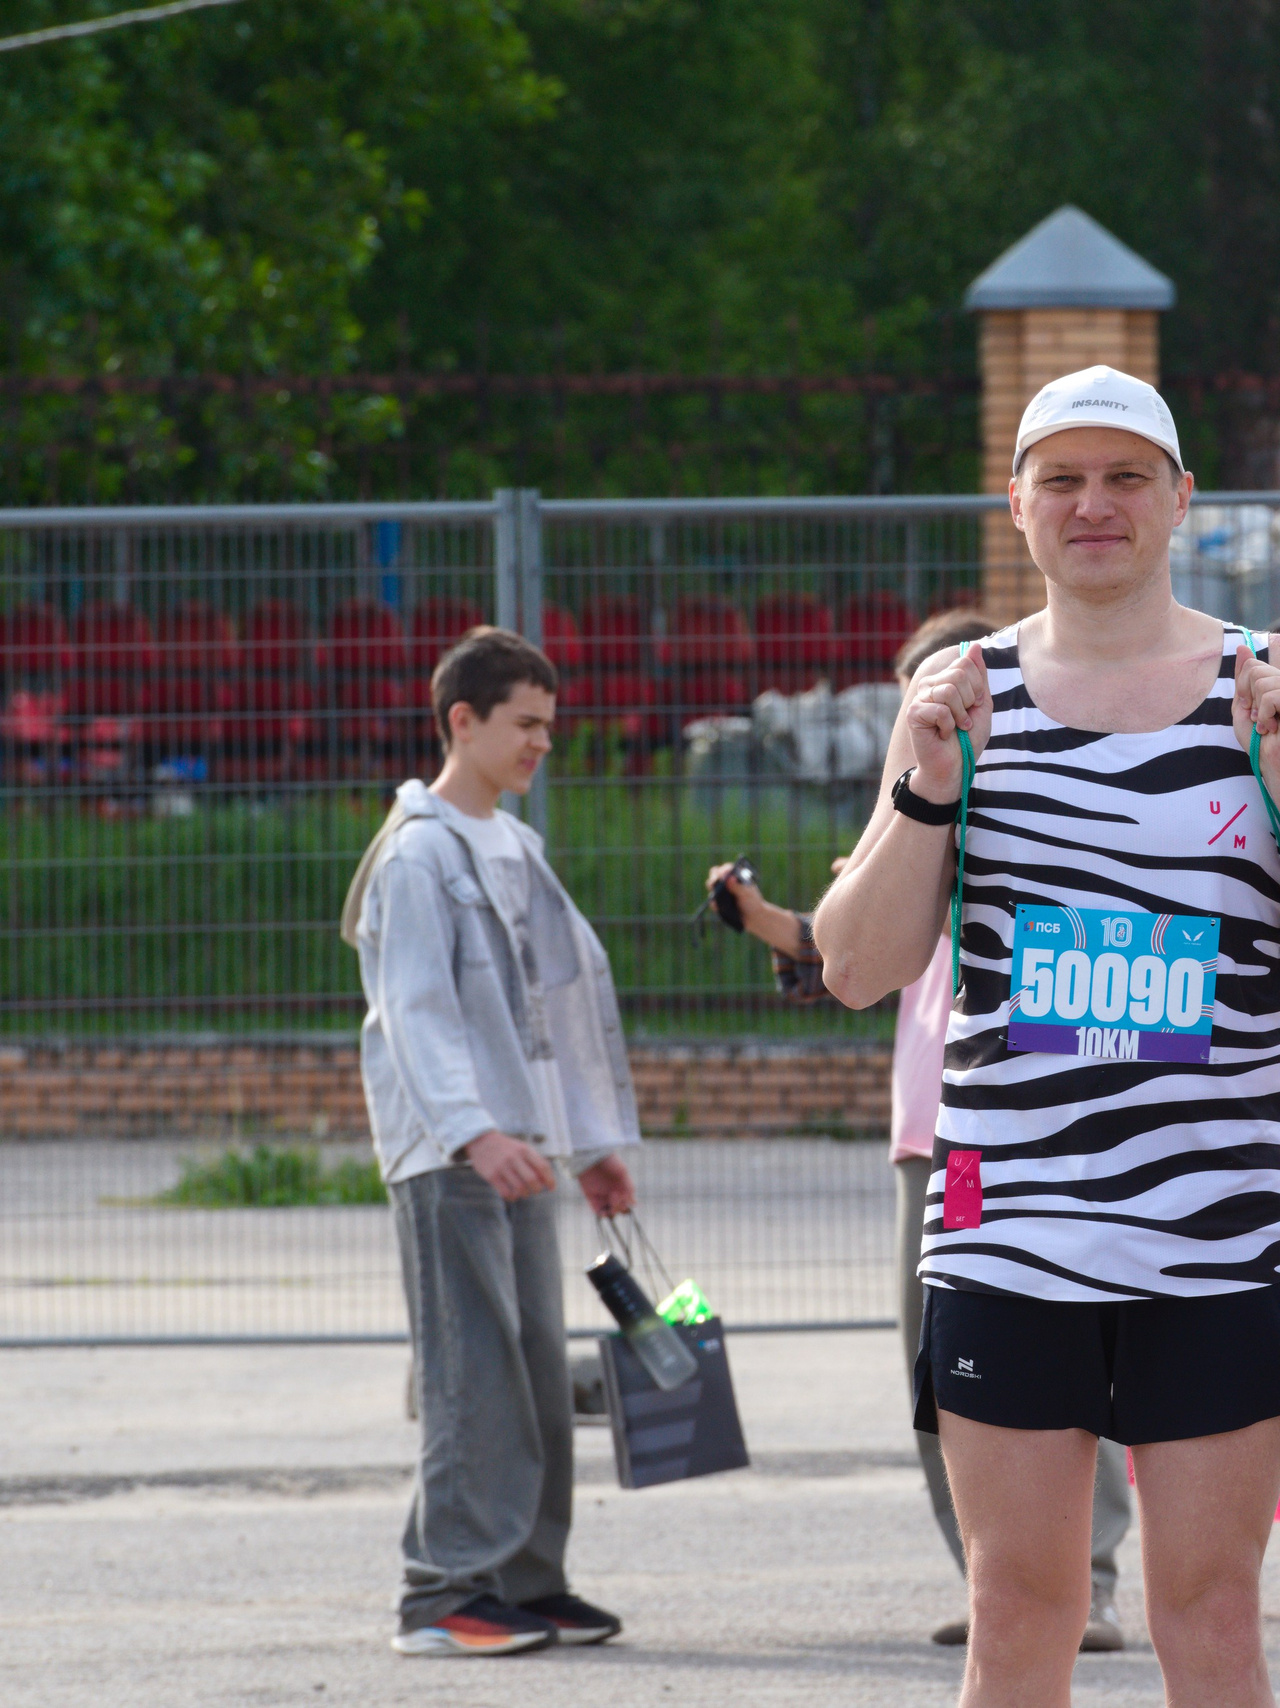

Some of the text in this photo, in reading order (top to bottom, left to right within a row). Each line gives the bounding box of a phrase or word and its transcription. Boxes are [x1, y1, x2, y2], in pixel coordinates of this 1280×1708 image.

[1071, 399, 1129, 412] INSANITY
[1209, 800, 1221, 815] U
[1233, 834, 1246, 850] M
[1035, 921, 1061, 934] ПСБ
[1100, 917, 1133, 948] 10
[1019, 947, 1204, 1028] 50090
[950, 1369, 982, 1379] NORDSKI
